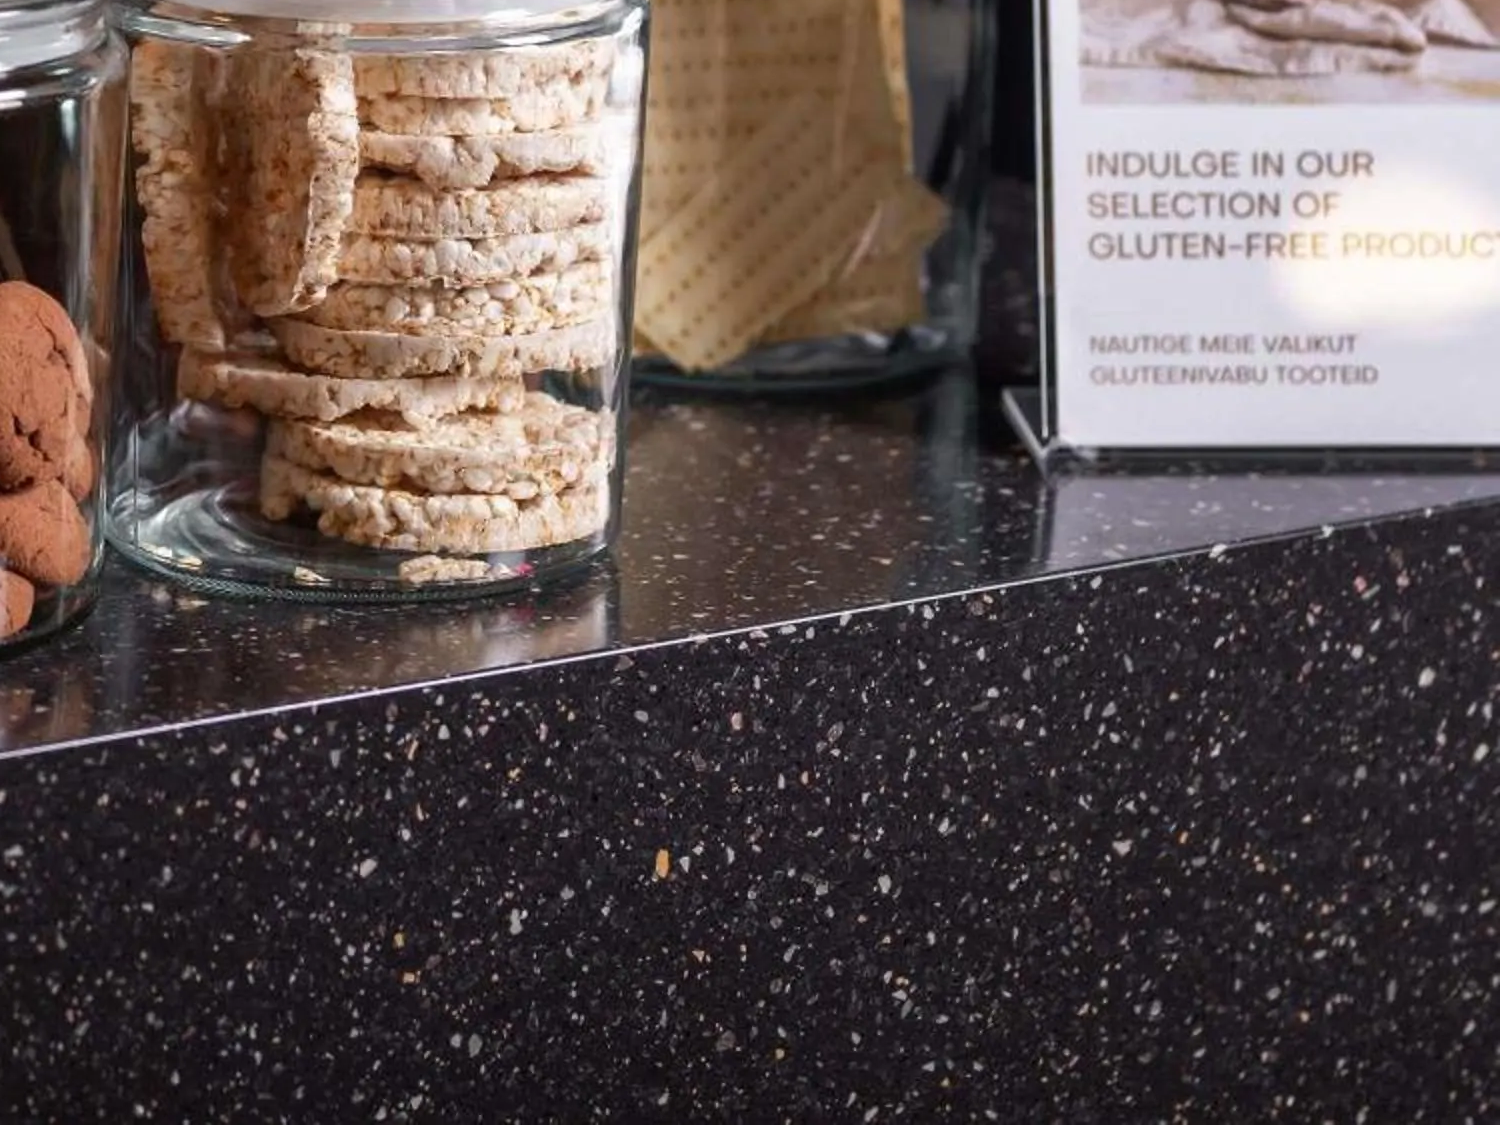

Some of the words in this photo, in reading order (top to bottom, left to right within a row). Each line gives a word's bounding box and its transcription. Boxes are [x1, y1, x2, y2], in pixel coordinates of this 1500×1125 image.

[1086, 150, 1240, 179] INDULGE
[1252, 151, 1284, 178] IN
[1296, 150, 1375, 178] OUR
[1087, 192, 1281, 219] SELECTION
[1293, 191, 1342, 219] OF
[1088, 232, 1328, 260] GLUTEN-FREE
[1090, 334, 1192, 354] NAUTIGE
[1200, 334, 1256, 354] MEIE
[1262, 334, 1357, 353] VALIKUT
[1090, 365, 1268, 385] GLUTEENIVABU
[1276, 365, 1380, 384] TOOTEID
